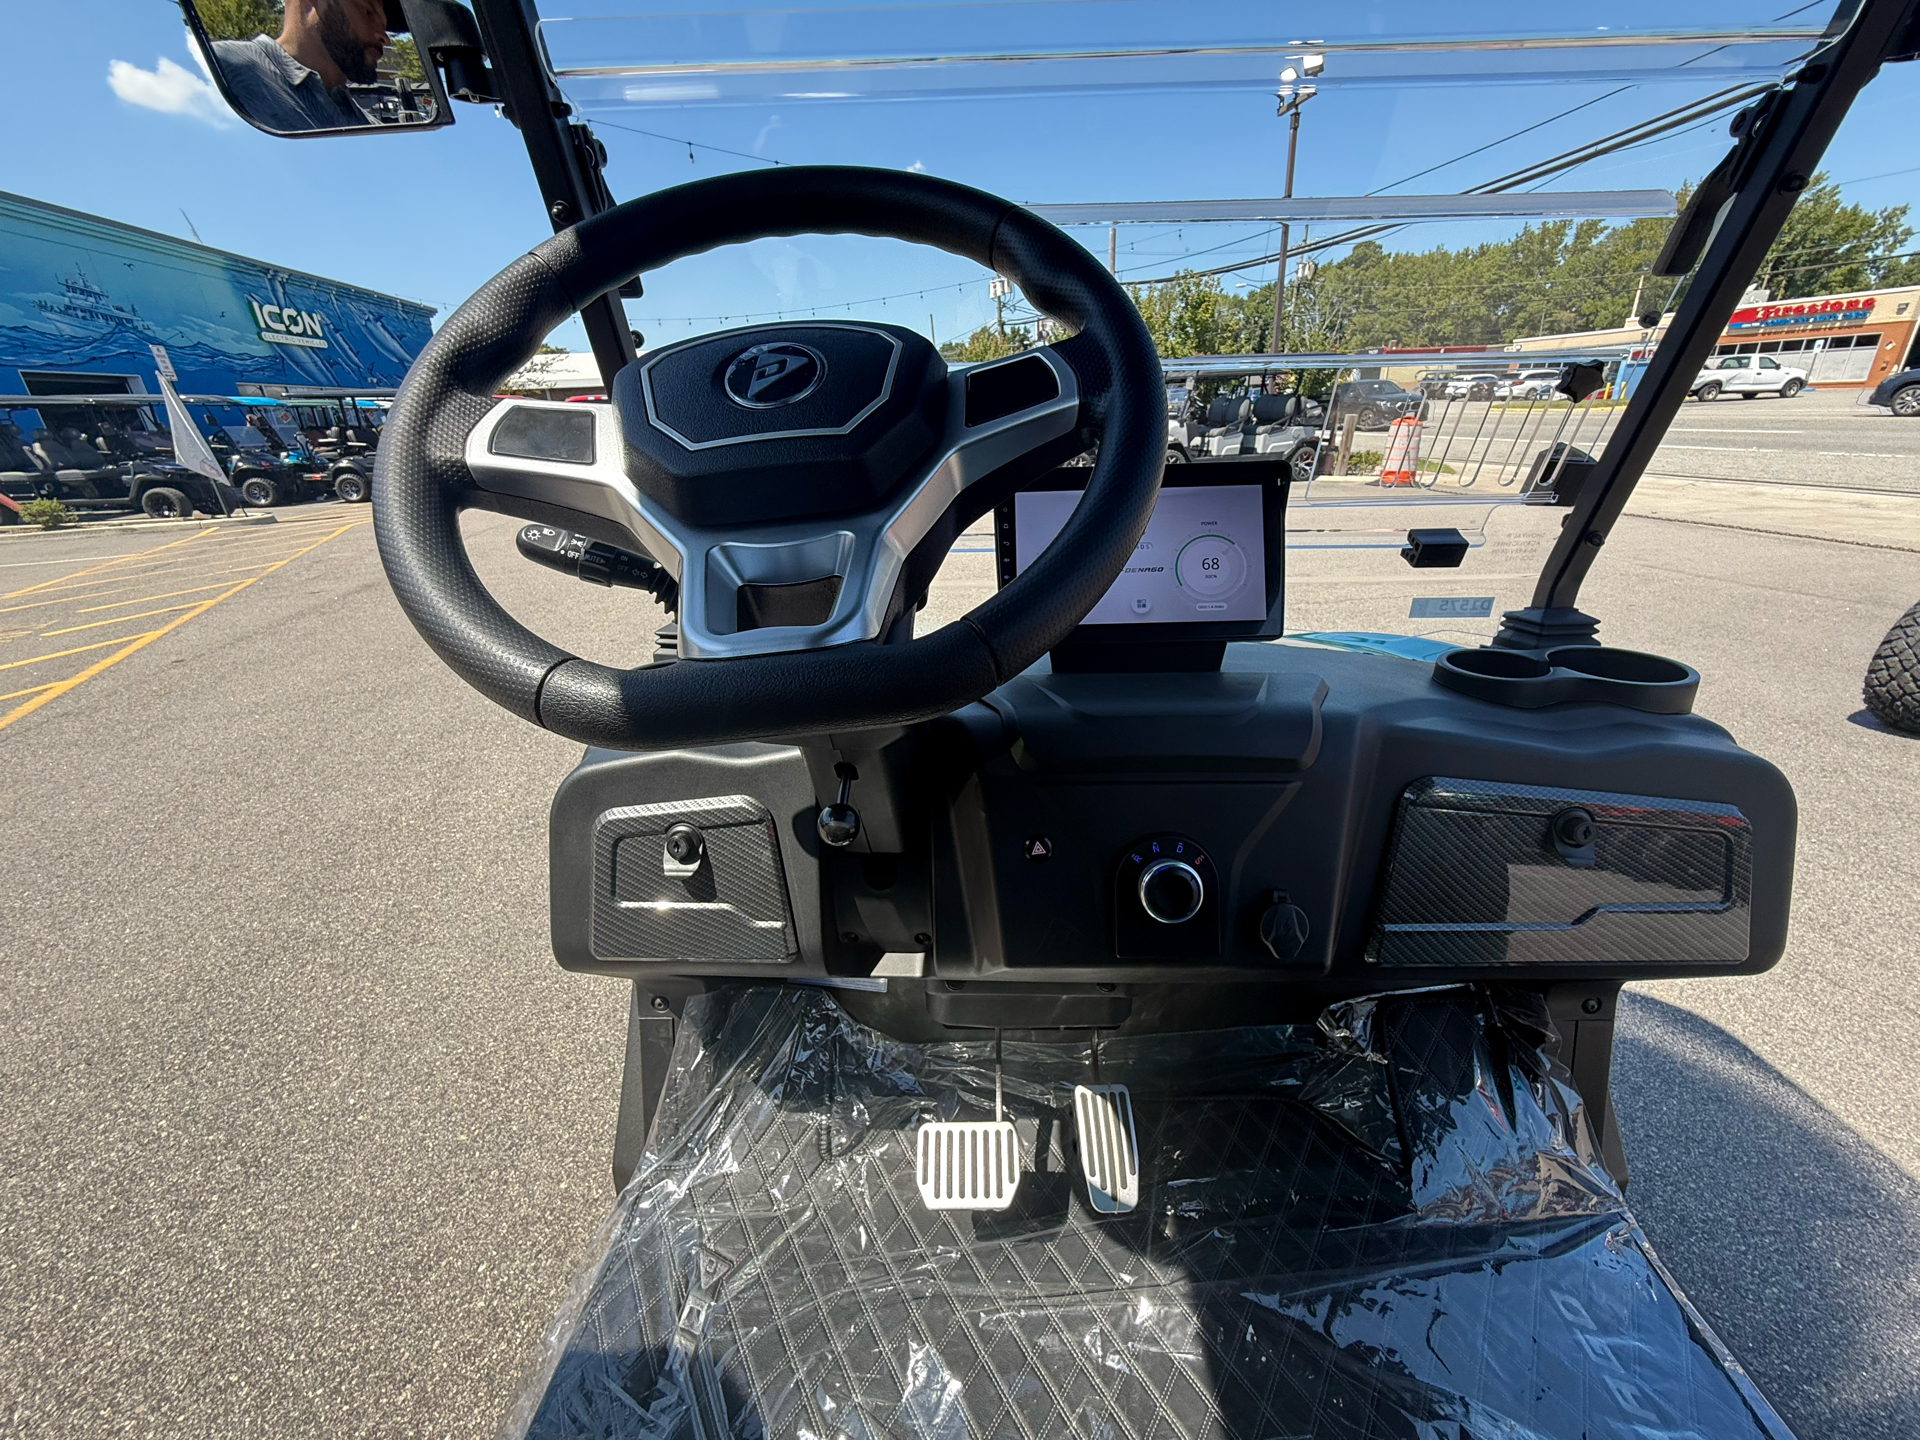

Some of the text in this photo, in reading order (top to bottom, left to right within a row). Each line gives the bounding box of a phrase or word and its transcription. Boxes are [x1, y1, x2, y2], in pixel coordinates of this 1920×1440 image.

[1758, 297, 1877, 321] Firestone
[252, 301, 323, 338] ICON
[264, 333, 327, 348] ELECTRIC VEHICLES
[567, 550, 601, 564] OFF MUTE
[1202, 557, 1220, 571] 68
[617, 564, 629, 572] OFF
